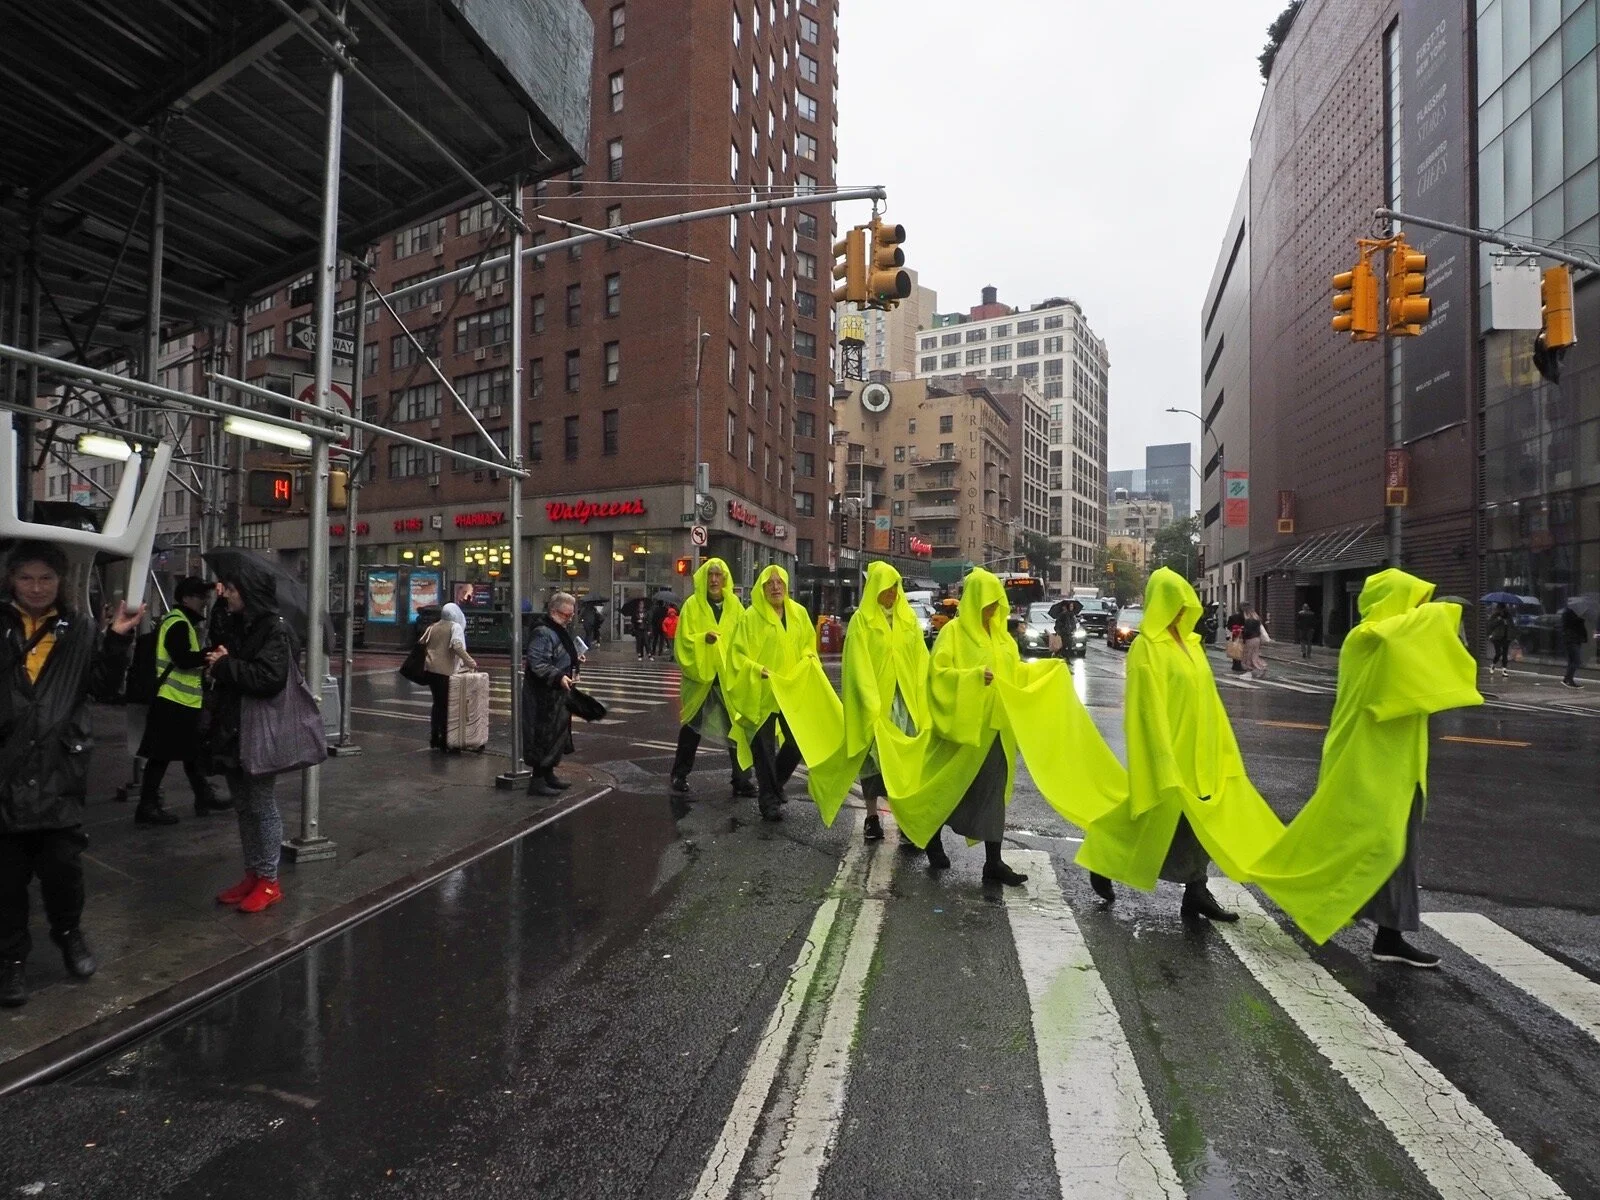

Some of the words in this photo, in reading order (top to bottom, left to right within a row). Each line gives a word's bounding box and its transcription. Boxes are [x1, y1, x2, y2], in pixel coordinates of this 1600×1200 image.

[1416, 83, 1447, 125] FLAGSHIP
[332, 338, 353, 353] WAY
[969, 398, 977, 459] TRUE
[274, 479, 291, 499] 14
[546, 498, 645, 524] Walgreens
[704, 501, 713, 511] 24
[968, 470, 977, 549] NORTH
[454, 511, 504, 527] PHARMACY
